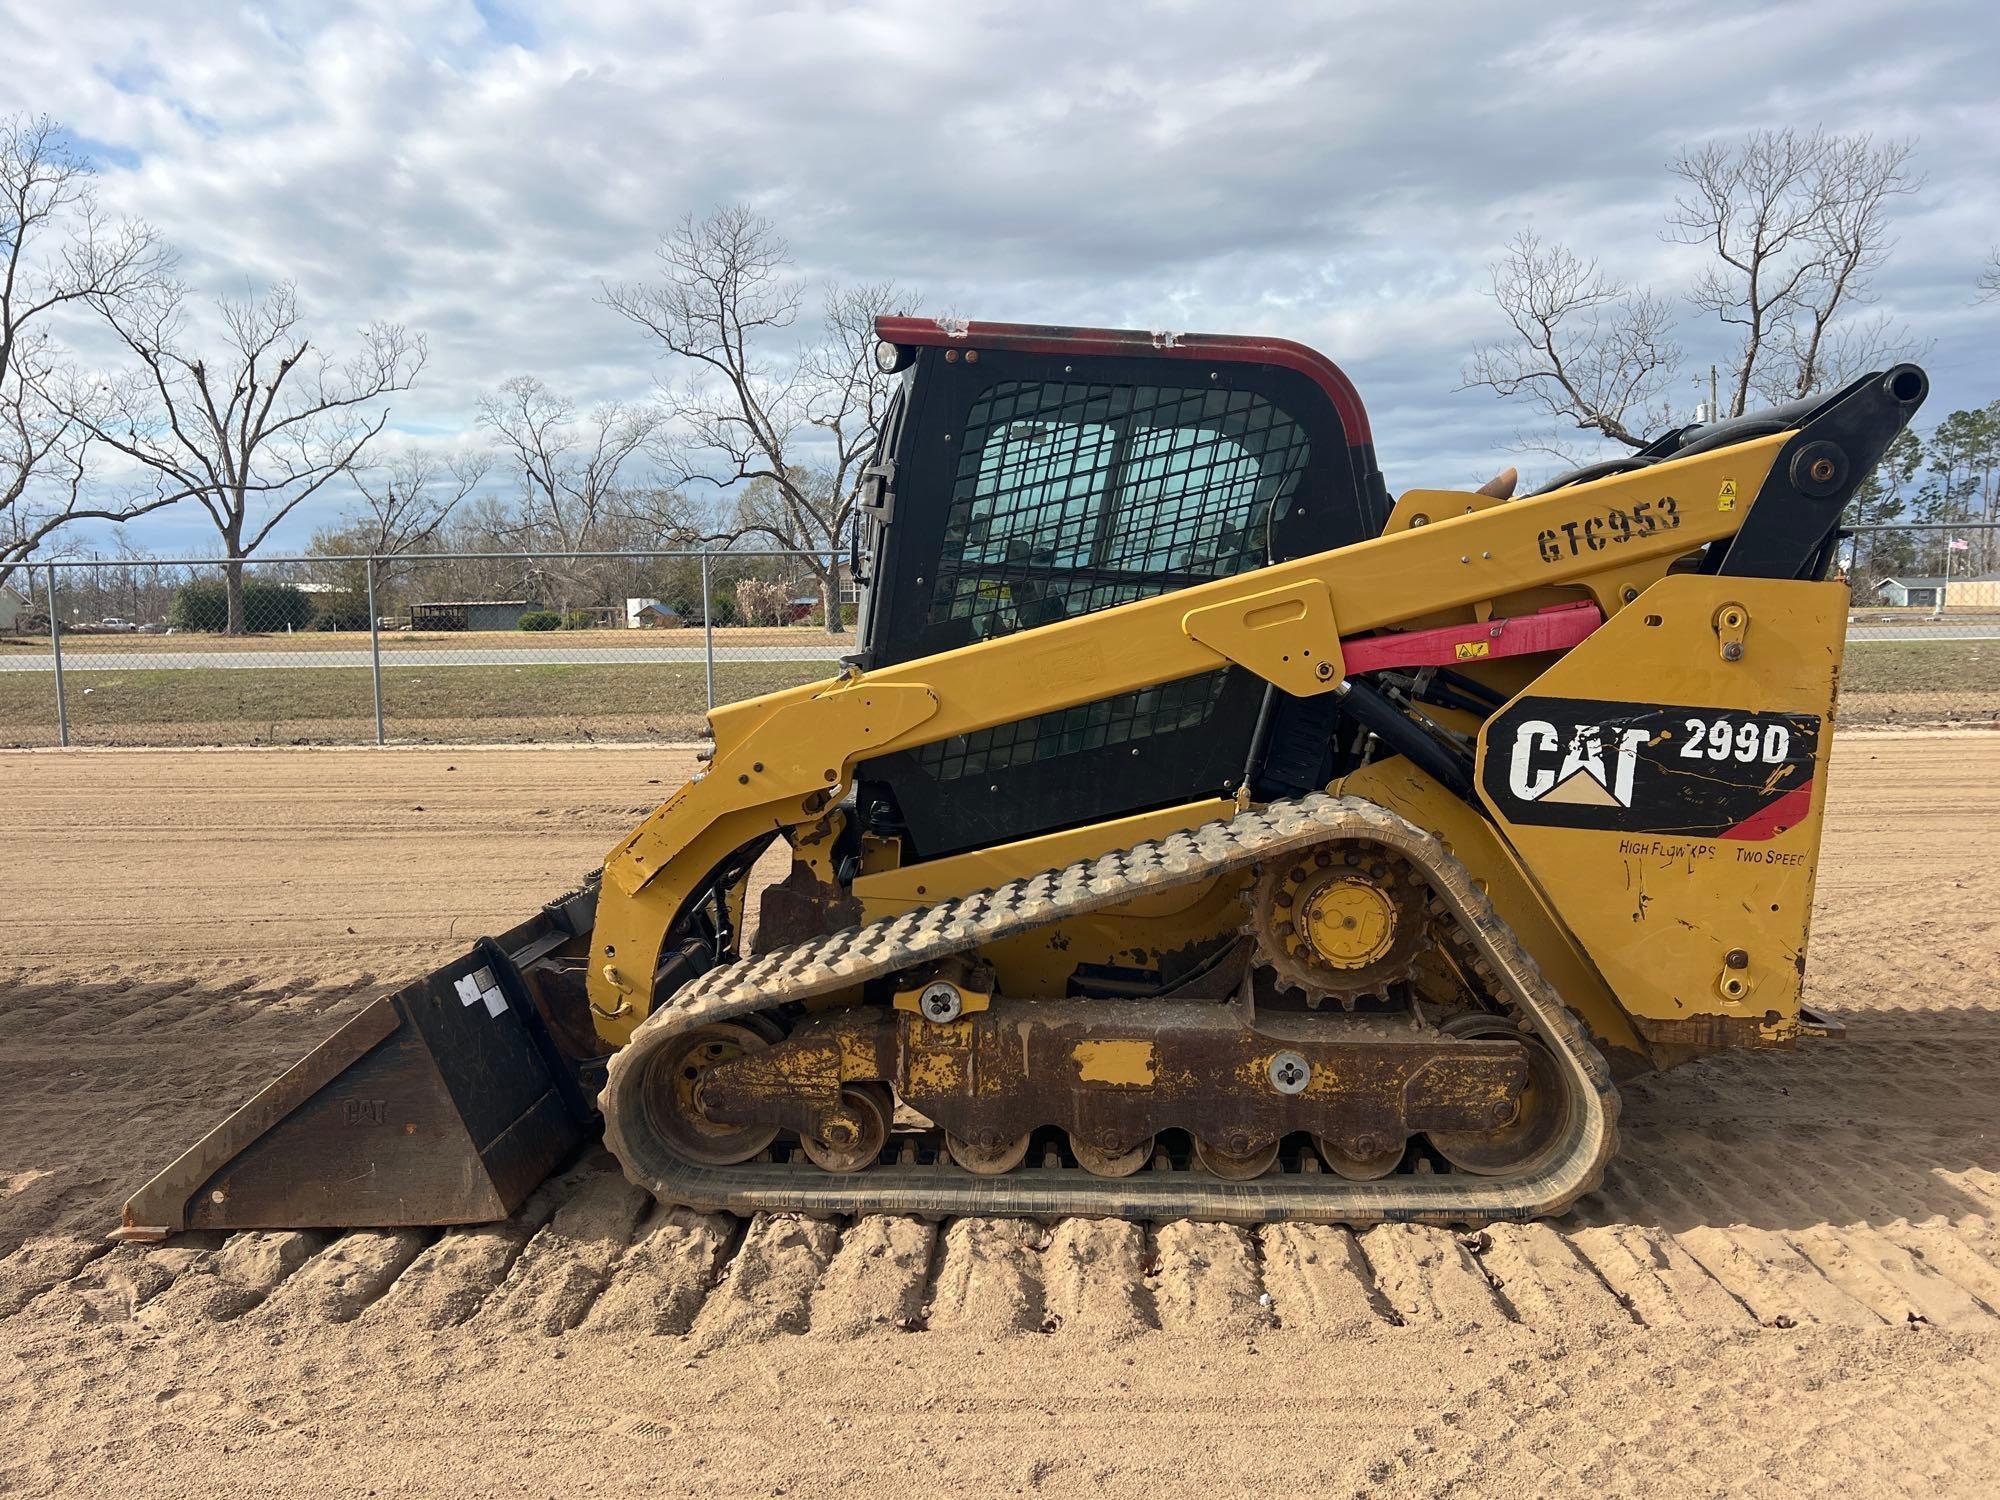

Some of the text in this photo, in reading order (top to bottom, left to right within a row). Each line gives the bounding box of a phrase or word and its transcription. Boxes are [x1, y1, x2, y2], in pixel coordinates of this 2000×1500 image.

[1538, 496, 1681, 562] GTC953
[1509, 718, 1790, 808] CAT 299D
[1619, 840, 1649, 854] HIGH
[1736, 848, 1762, 863] TWO
[343, 1099, 386, 1125] CAT
